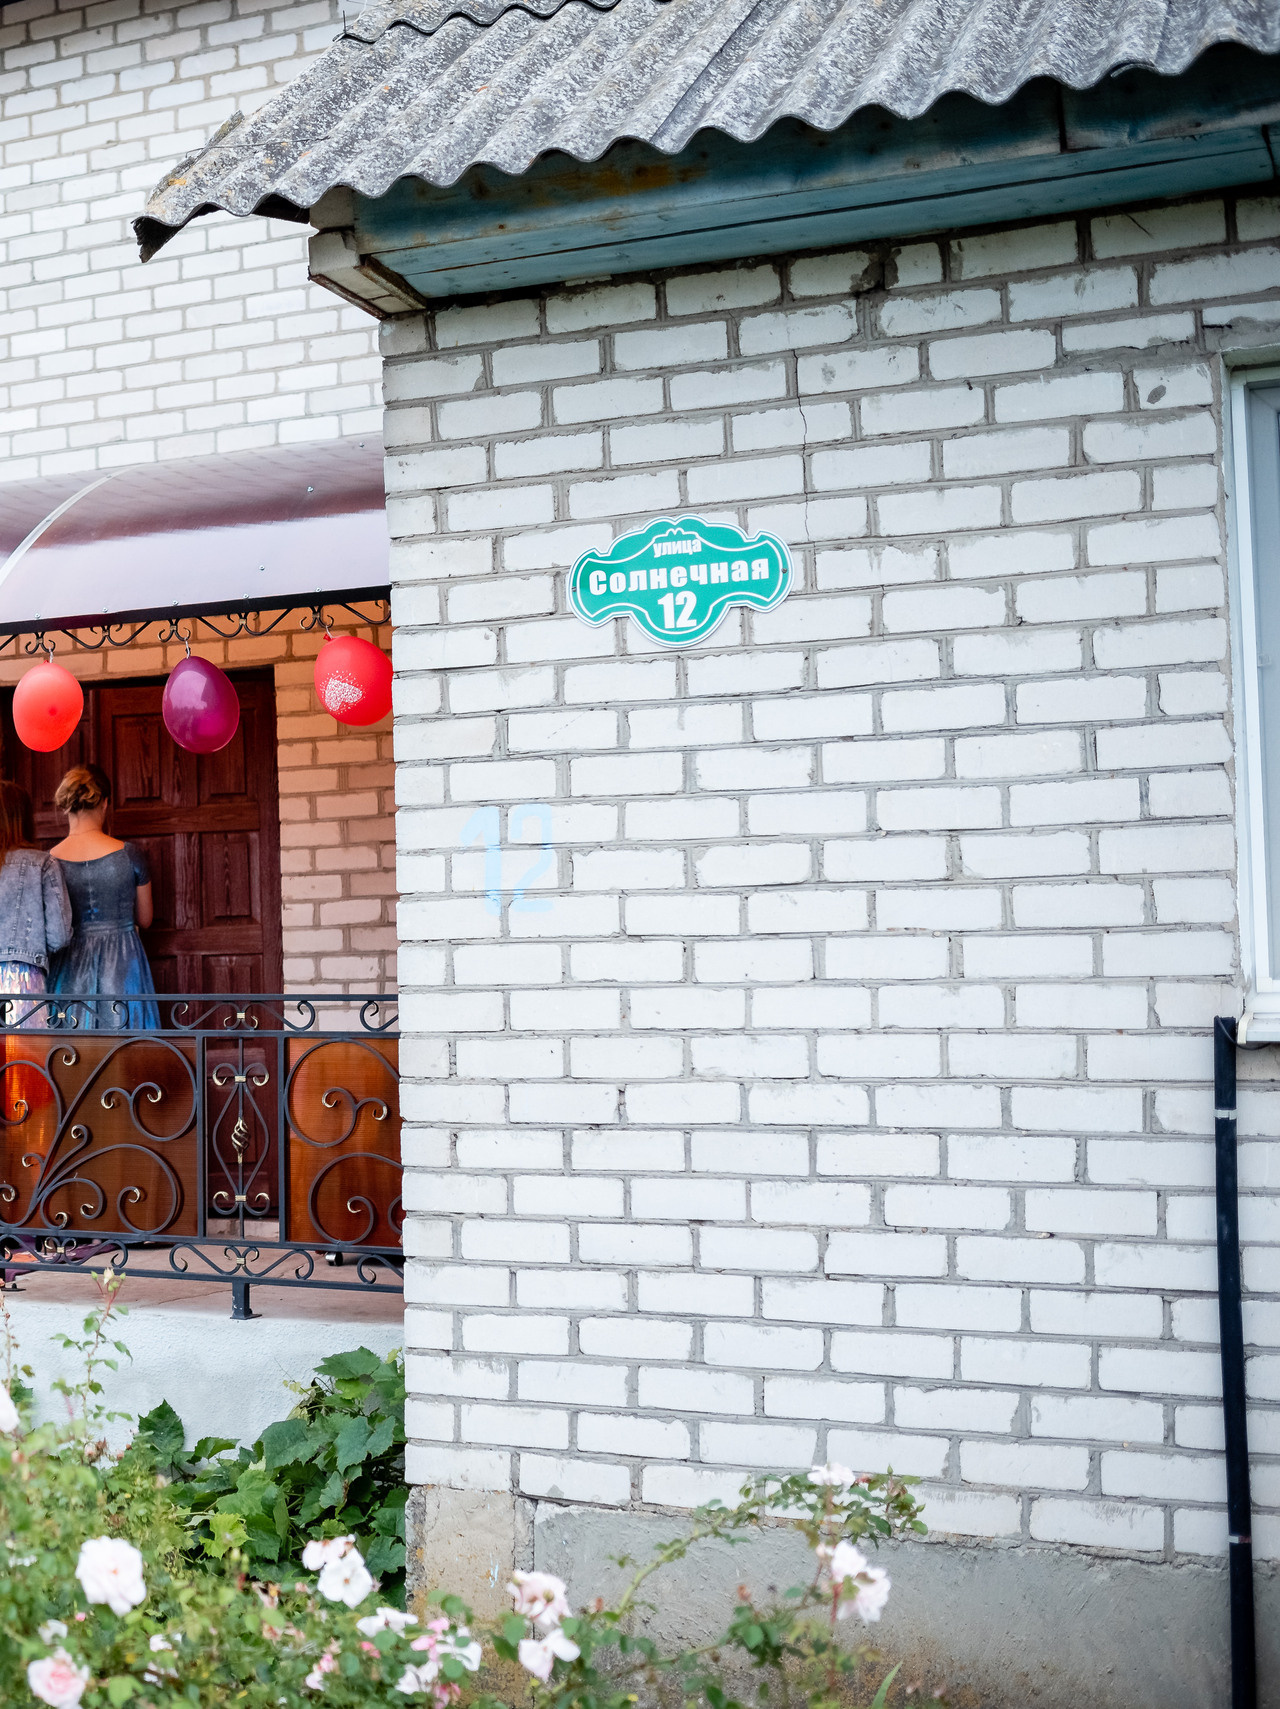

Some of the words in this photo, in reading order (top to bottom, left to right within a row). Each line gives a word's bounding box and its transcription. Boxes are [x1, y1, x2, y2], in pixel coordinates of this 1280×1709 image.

[653, 537, 702, 558] улица
[589, 558, 769, 596] Солнечная
[657, 590, 698, 629] 12
[459, 803, 554, 916] 12
